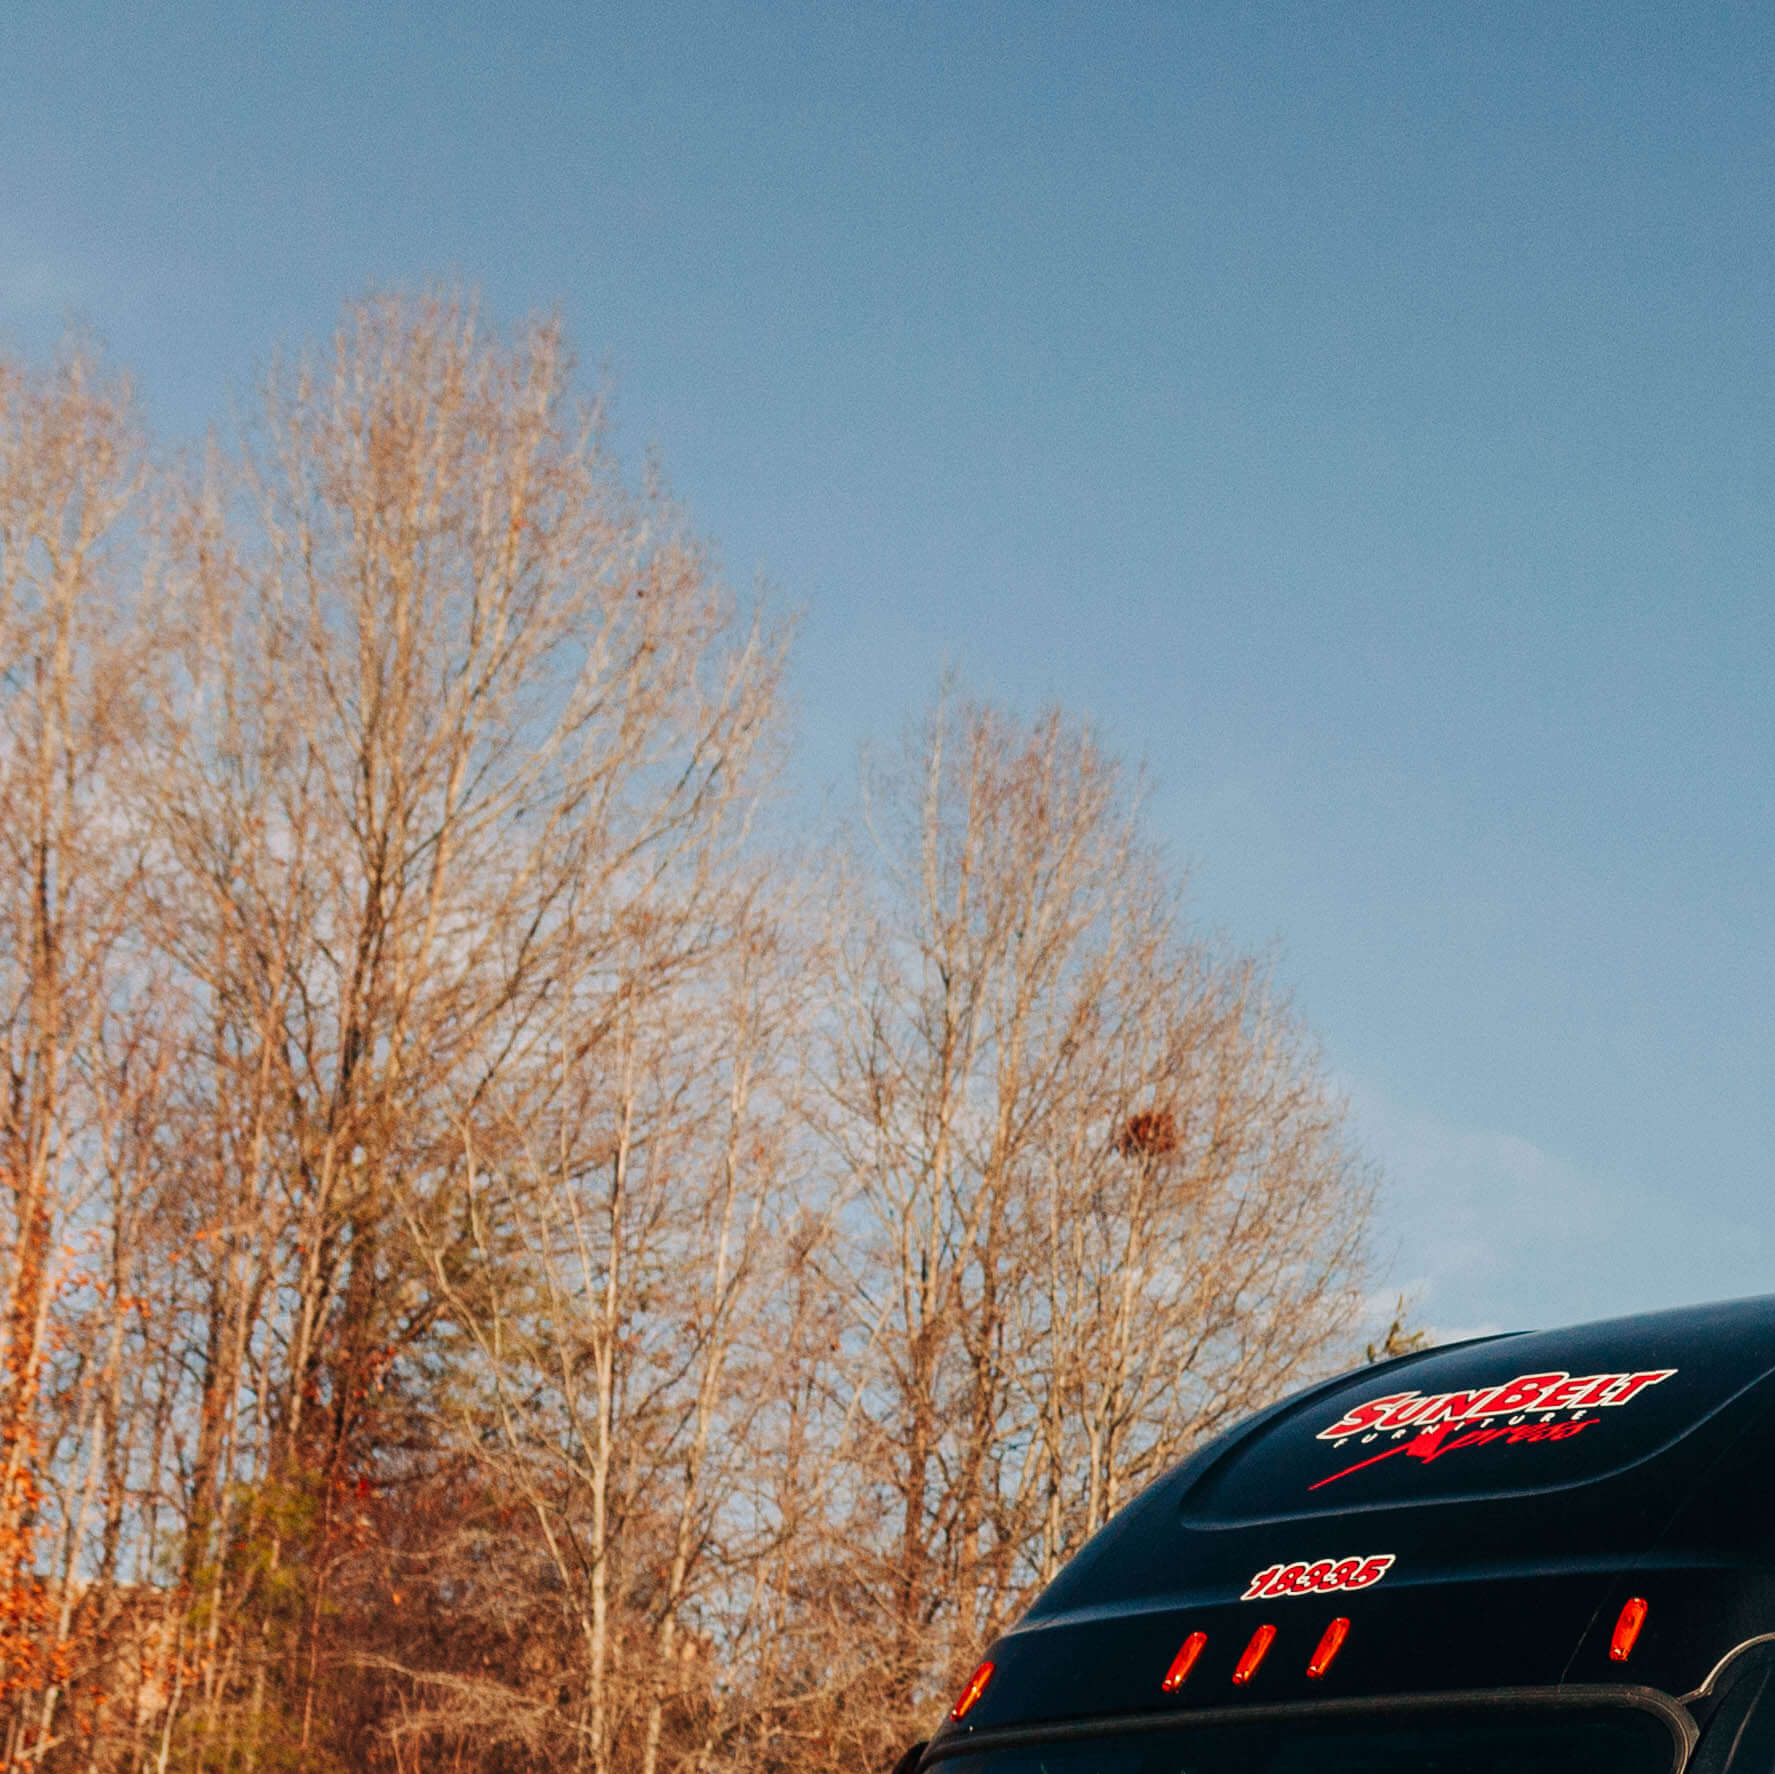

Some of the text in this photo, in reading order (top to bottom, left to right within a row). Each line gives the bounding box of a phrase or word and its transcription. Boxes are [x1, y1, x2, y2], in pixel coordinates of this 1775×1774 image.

[1307, 1415, 1600, 1490] Xpress
[1333, 1409, 1588, 1449] FURNITURE
[1241, 1553, 1396, 1600] 18335
